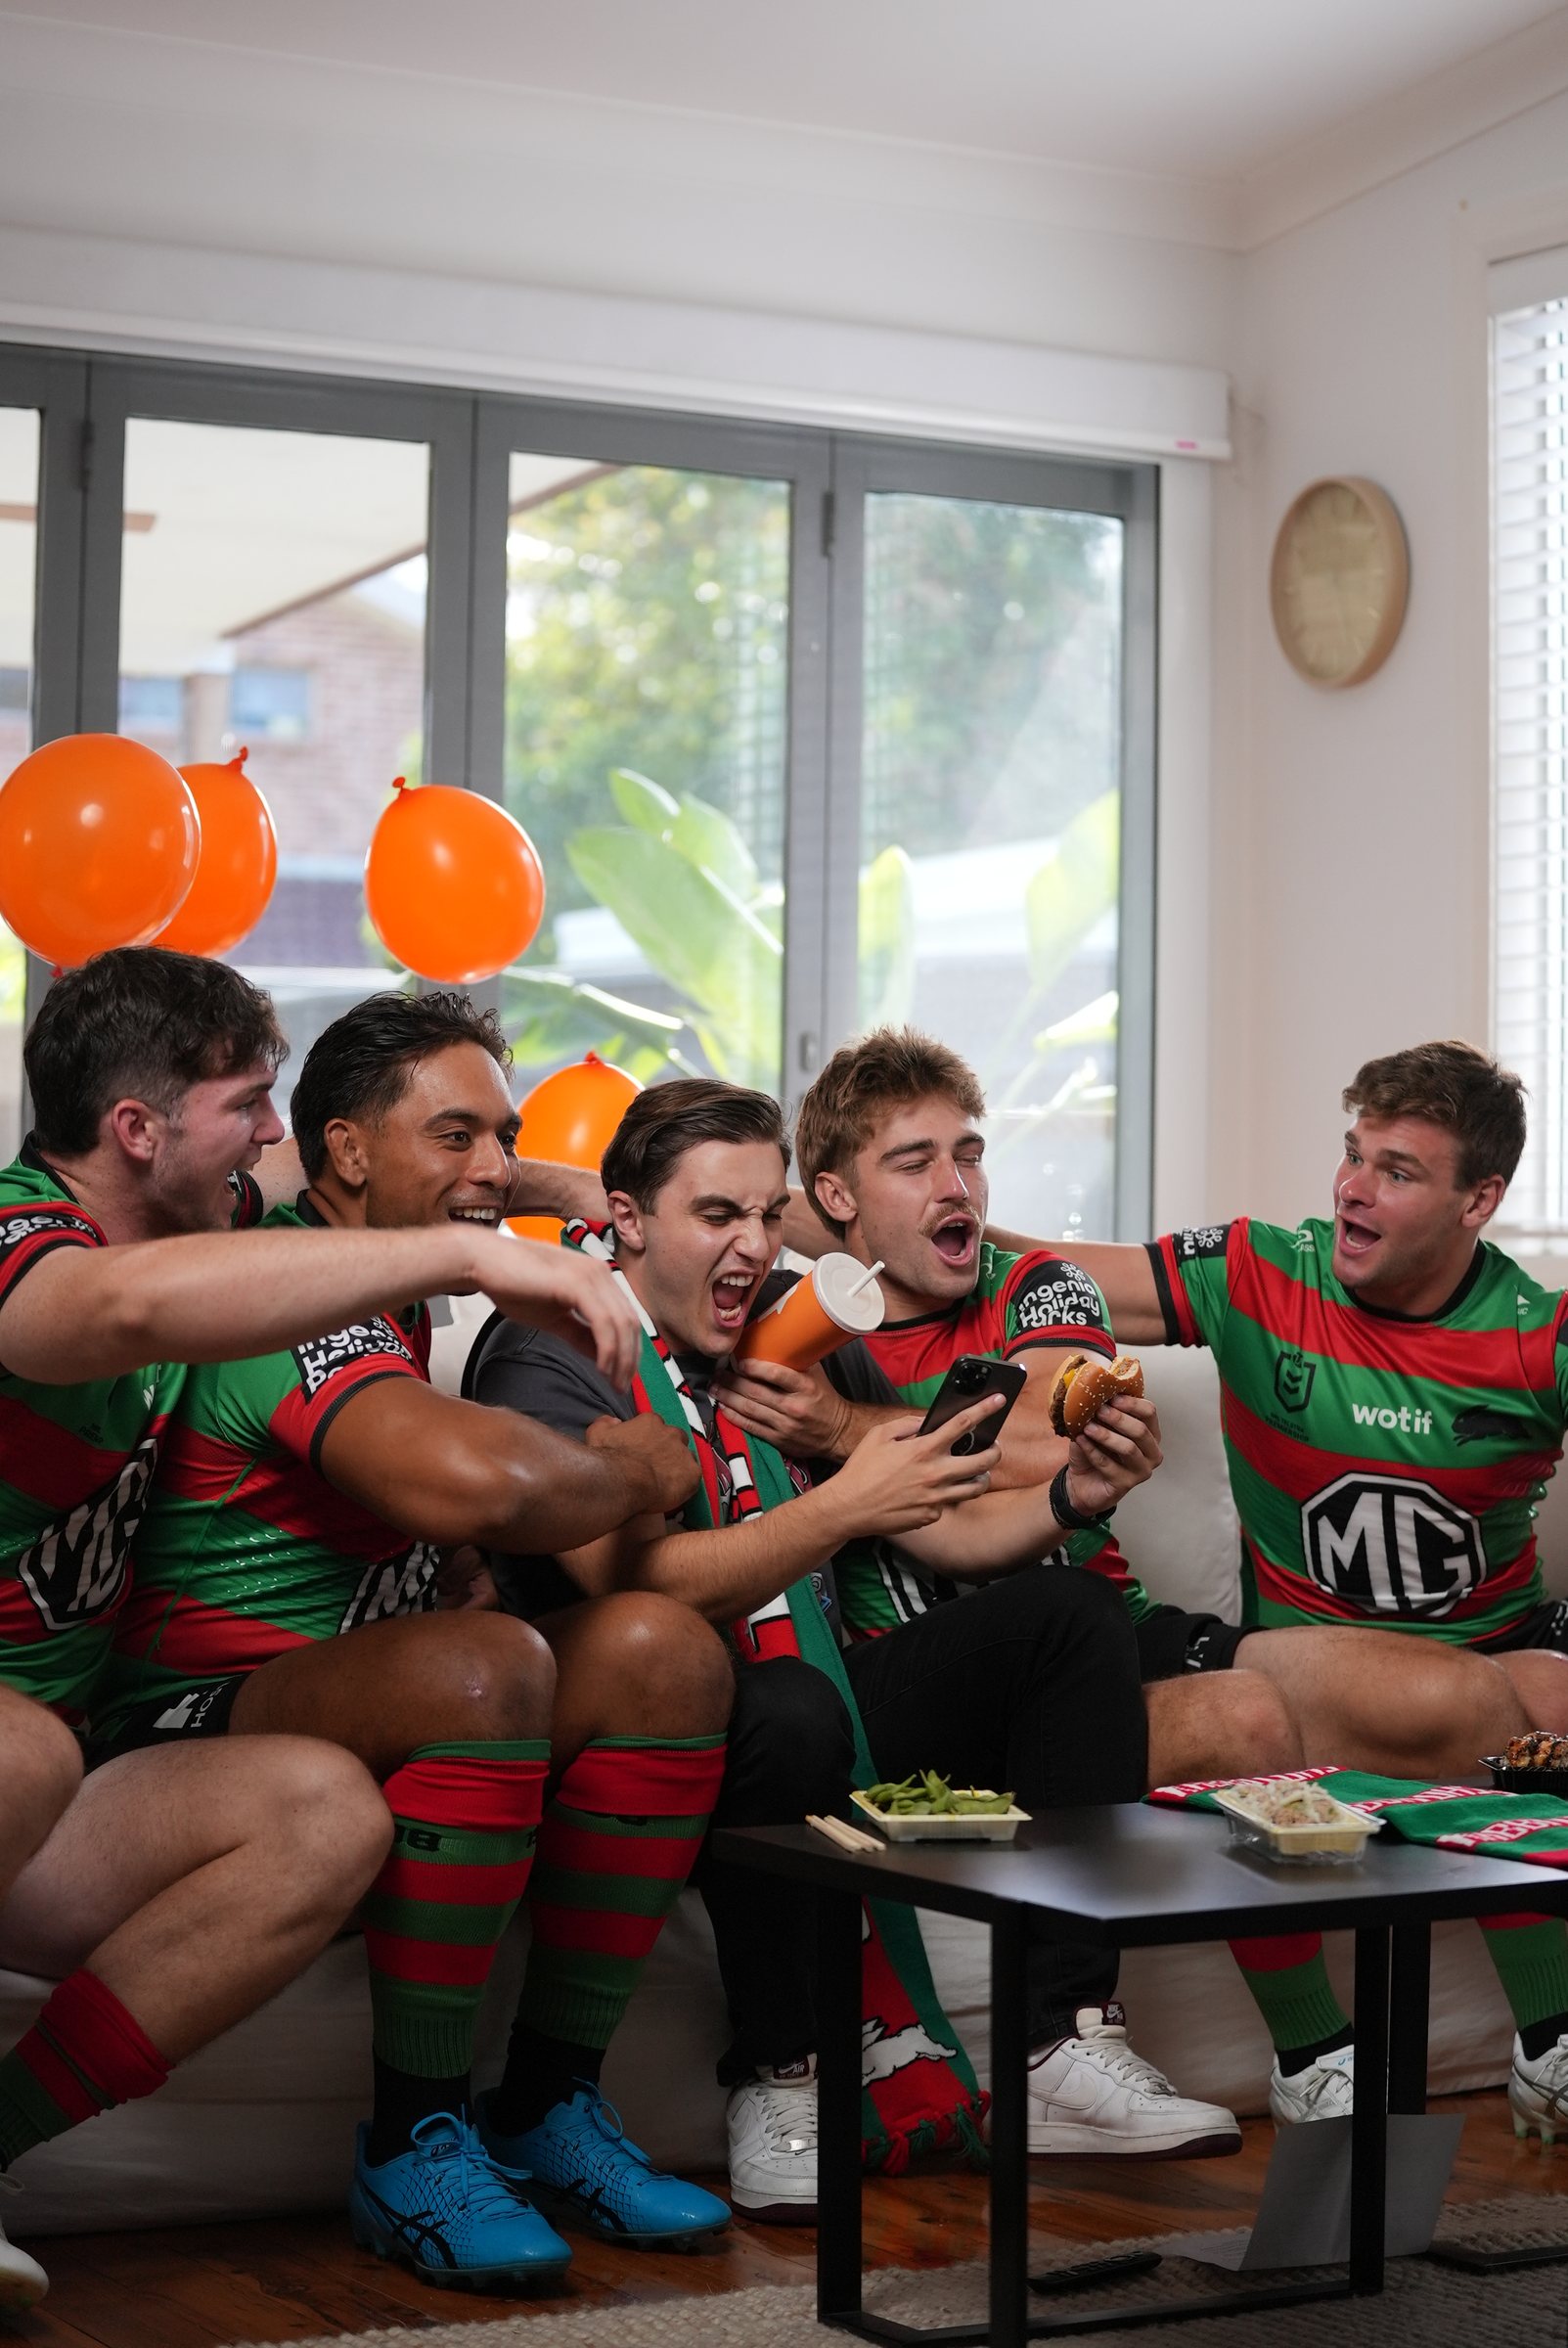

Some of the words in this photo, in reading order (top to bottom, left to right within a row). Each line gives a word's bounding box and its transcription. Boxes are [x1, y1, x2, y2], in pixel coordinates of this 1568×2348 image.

[1018, 1280, 1097, 1312] ingenia
[1352, 1403, 1433, 1435] wotif
[1318, 1491, 1472, 1611] MG
